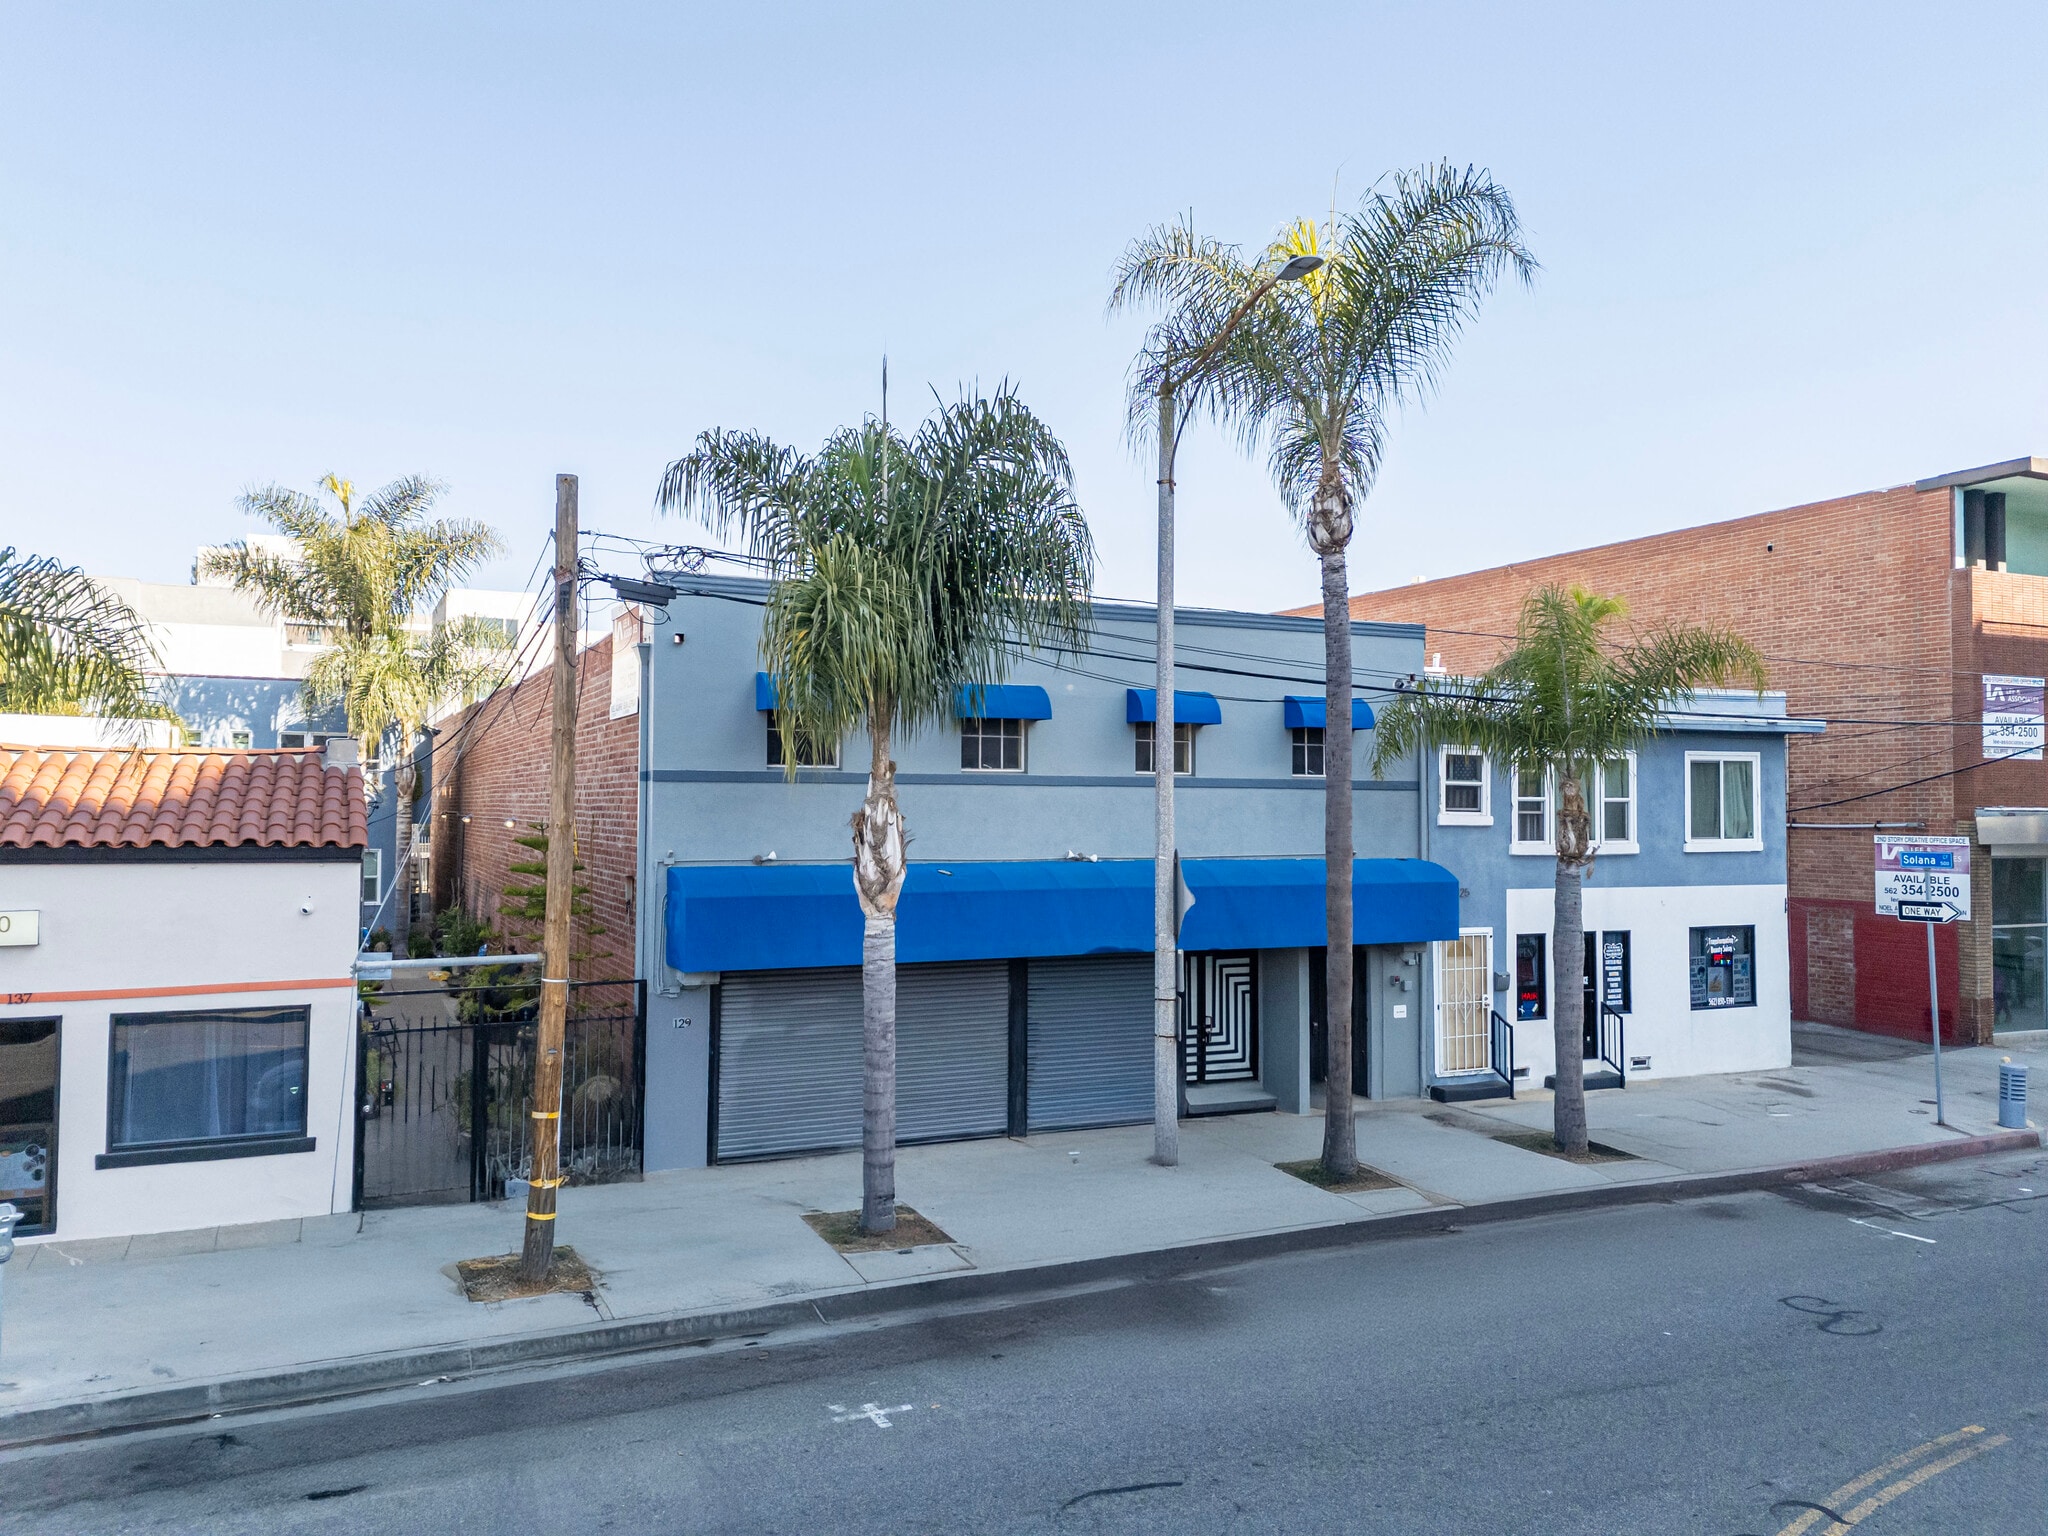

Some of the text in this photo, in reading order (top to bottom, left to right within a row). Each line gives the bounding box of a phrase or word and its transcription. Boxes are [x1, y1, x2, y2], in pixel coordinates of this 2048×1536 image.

[2000, 726, 2038, 738] 354-2500
[1903, 855, 1936, 865] Solana
[1901, 884, 1960, 898] 354-2500
[1904, 907, 1920, 916] ONE
[1924, 908, 1941, 917] WAY
[7, 992, 32, 1005] 137
[673, 1017, 691, 1029] 129
